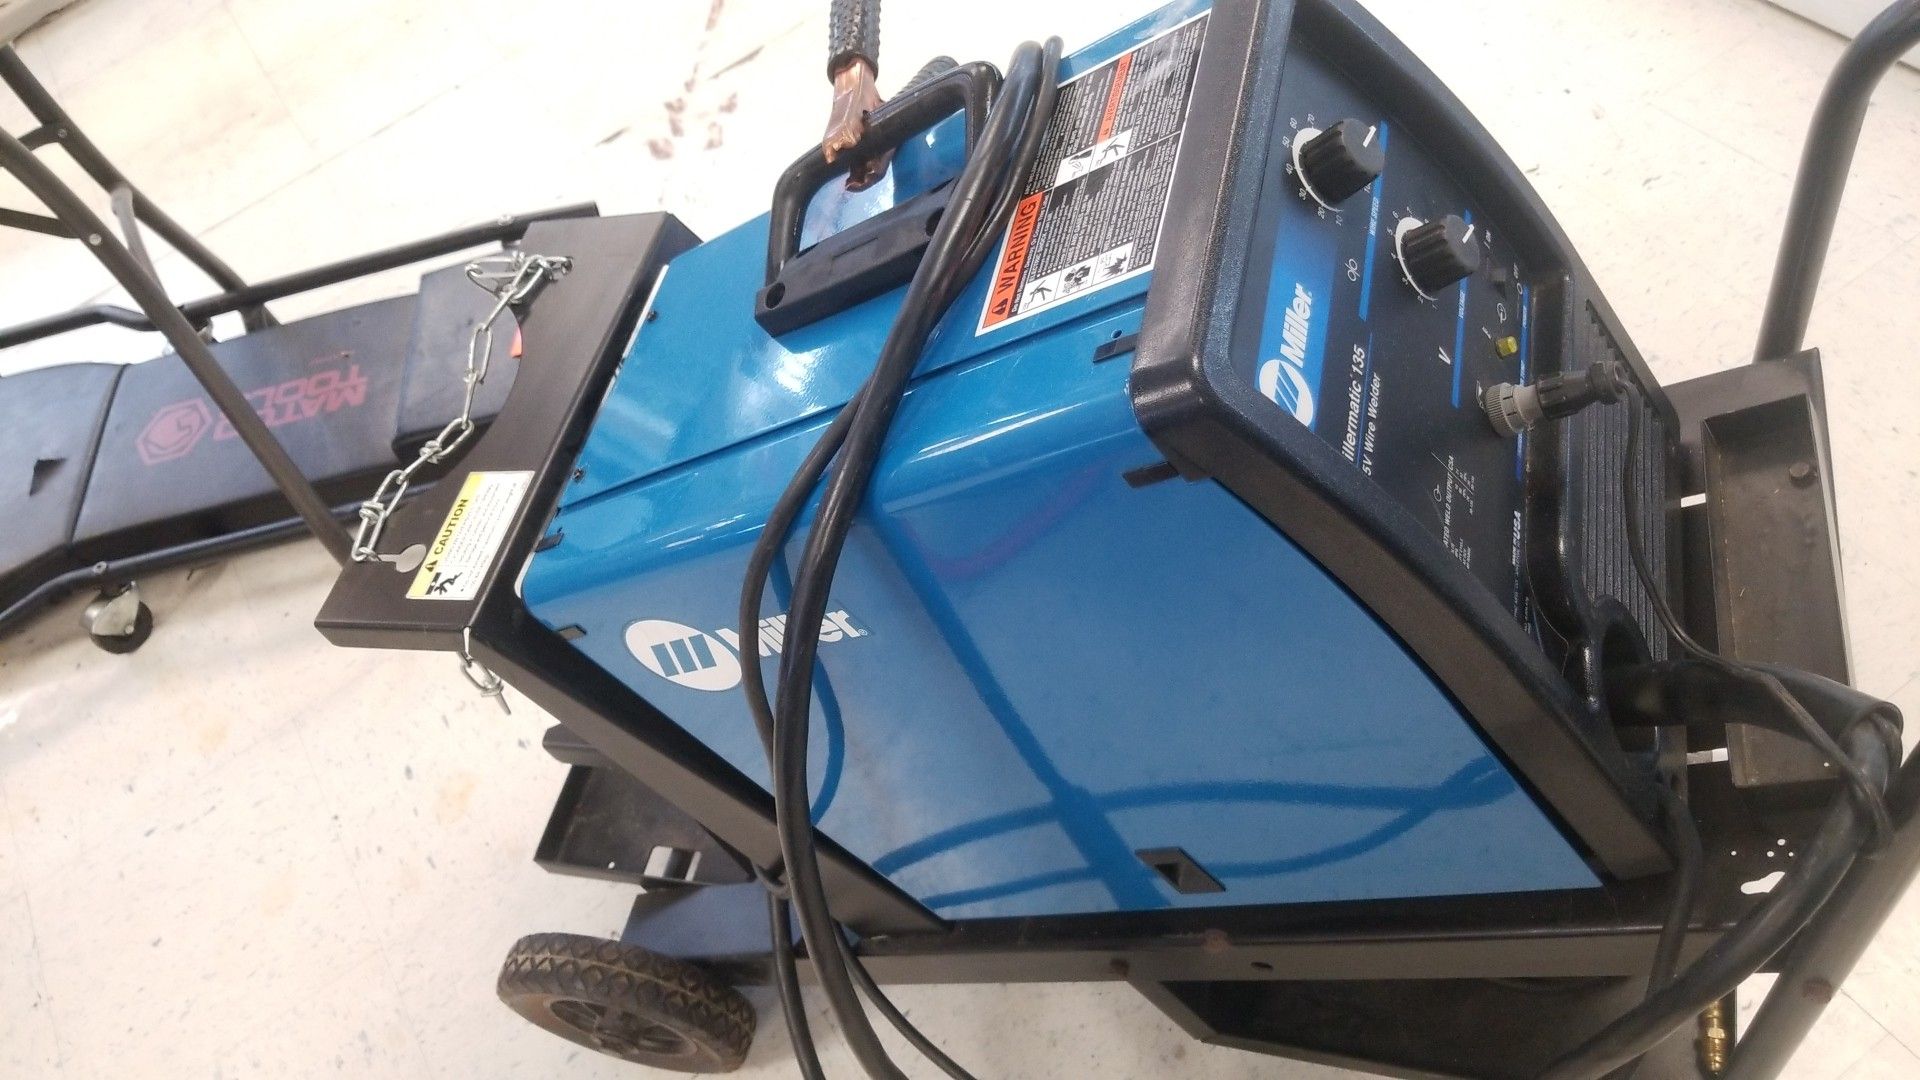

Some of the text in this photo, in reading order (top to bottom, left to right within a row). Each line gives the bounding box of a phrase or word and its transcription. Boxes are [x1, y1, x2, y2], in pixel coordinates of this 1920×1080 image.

[1289, 117, 1298, 130] 60
[1308, 113, 1315, 125] 70
[1282, 135, 1290, 148] 50
[1285, 163, 1294, 175] 40
[1298, 188, 1307, 200] 30
[1318, 207, 1326, 219] 20
[1369, 196, 1379, 237] WIRE SPEED
[996, 200, 1037, 295] WARNING
[1279, 283, 1313, 369] Miller
[1341, 343, 1366, 462] illermatic 135
[1366, 371, 1382, 420] Welder
[1363, 420, 1378, 454] Wire
[434, 498, 469, 554] CAUTION
[1512, 510, 1521, 540] USA
[714, 609, 863, 657] Miler
